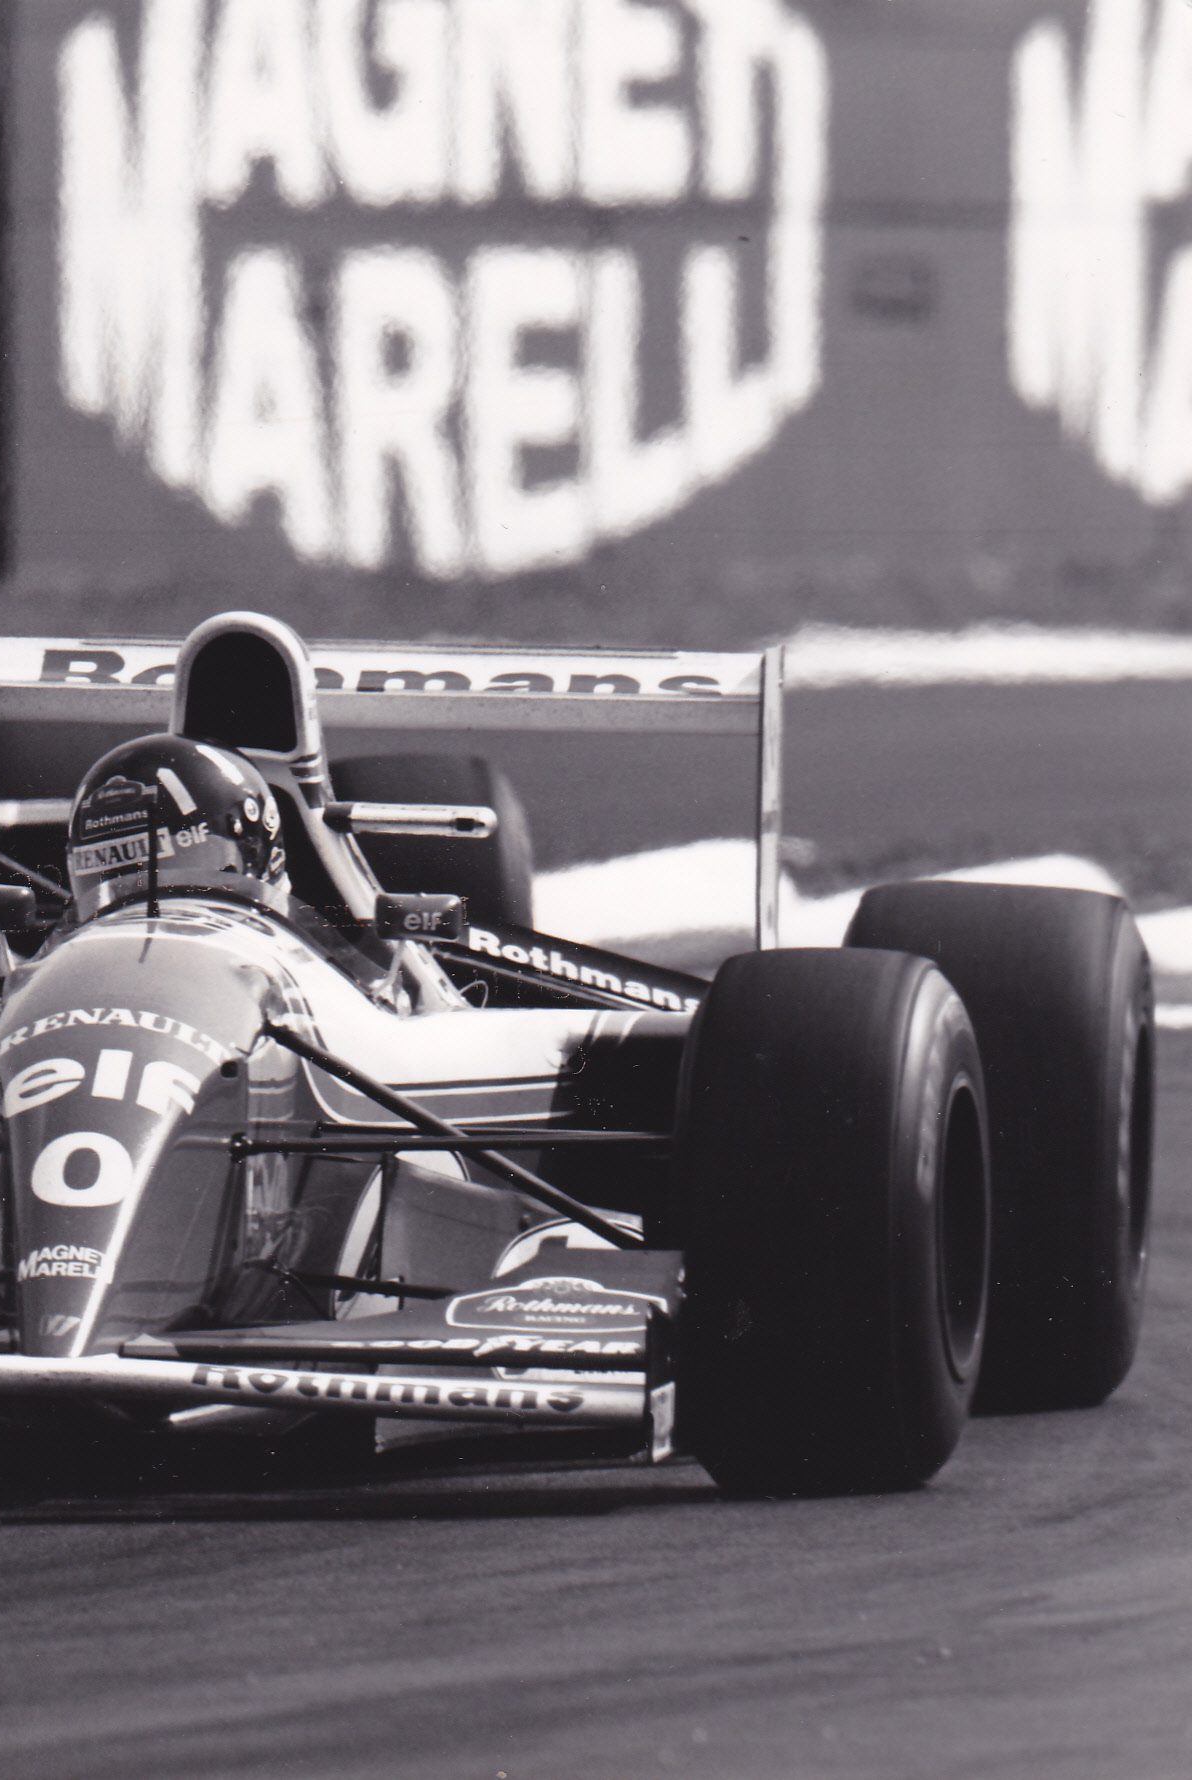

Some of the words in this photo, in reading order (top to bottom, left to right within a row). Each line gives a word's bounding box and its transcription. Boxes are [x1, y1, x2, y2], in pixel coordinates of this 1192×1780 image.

[58, 238, 826, 582] MARELLI
[39, 648, 724, 697] Romans
[176, 822, 210, 848] elf
[403, 911, 443, 931] elf
[4, 1048, 203, 1118] elf
[476, 1295, 641, 1316] Rothmans
[191, 1364, 586, 1413] Rothmans
